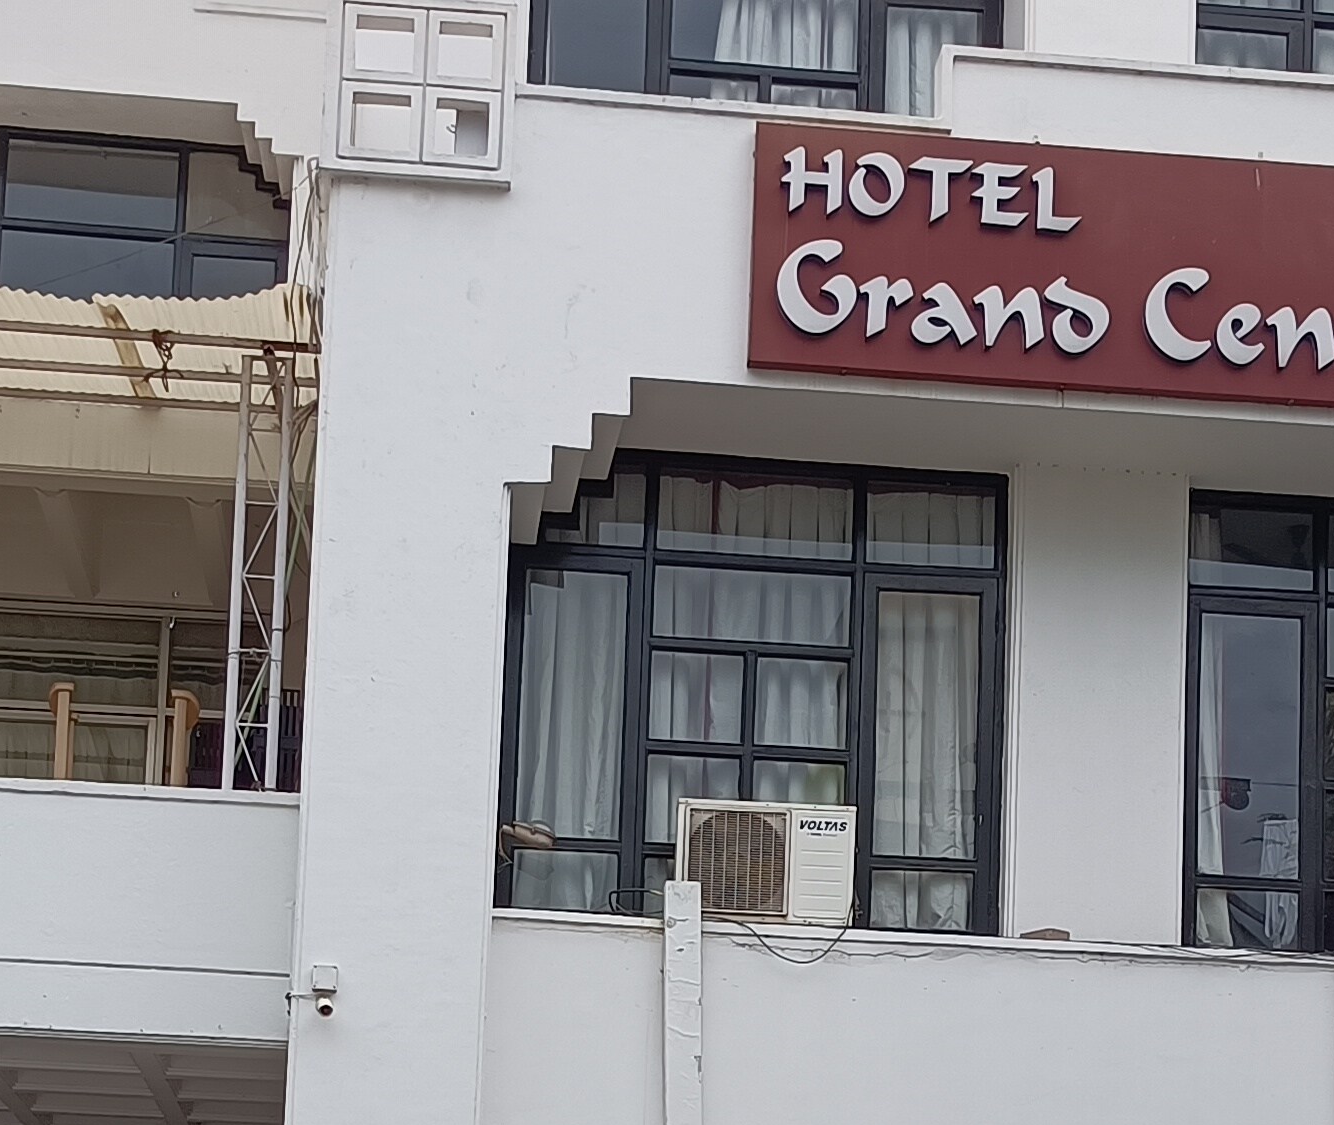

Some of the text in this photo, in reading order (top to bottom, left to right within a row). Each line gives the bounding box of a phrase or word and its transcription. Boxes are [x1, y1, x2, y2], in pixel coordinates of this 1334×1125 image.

[780, 145, 1083, 232] HOTEL
[776, 238, 1111, 355] Grand
[799, 819, 848, 832] VOLTAS
